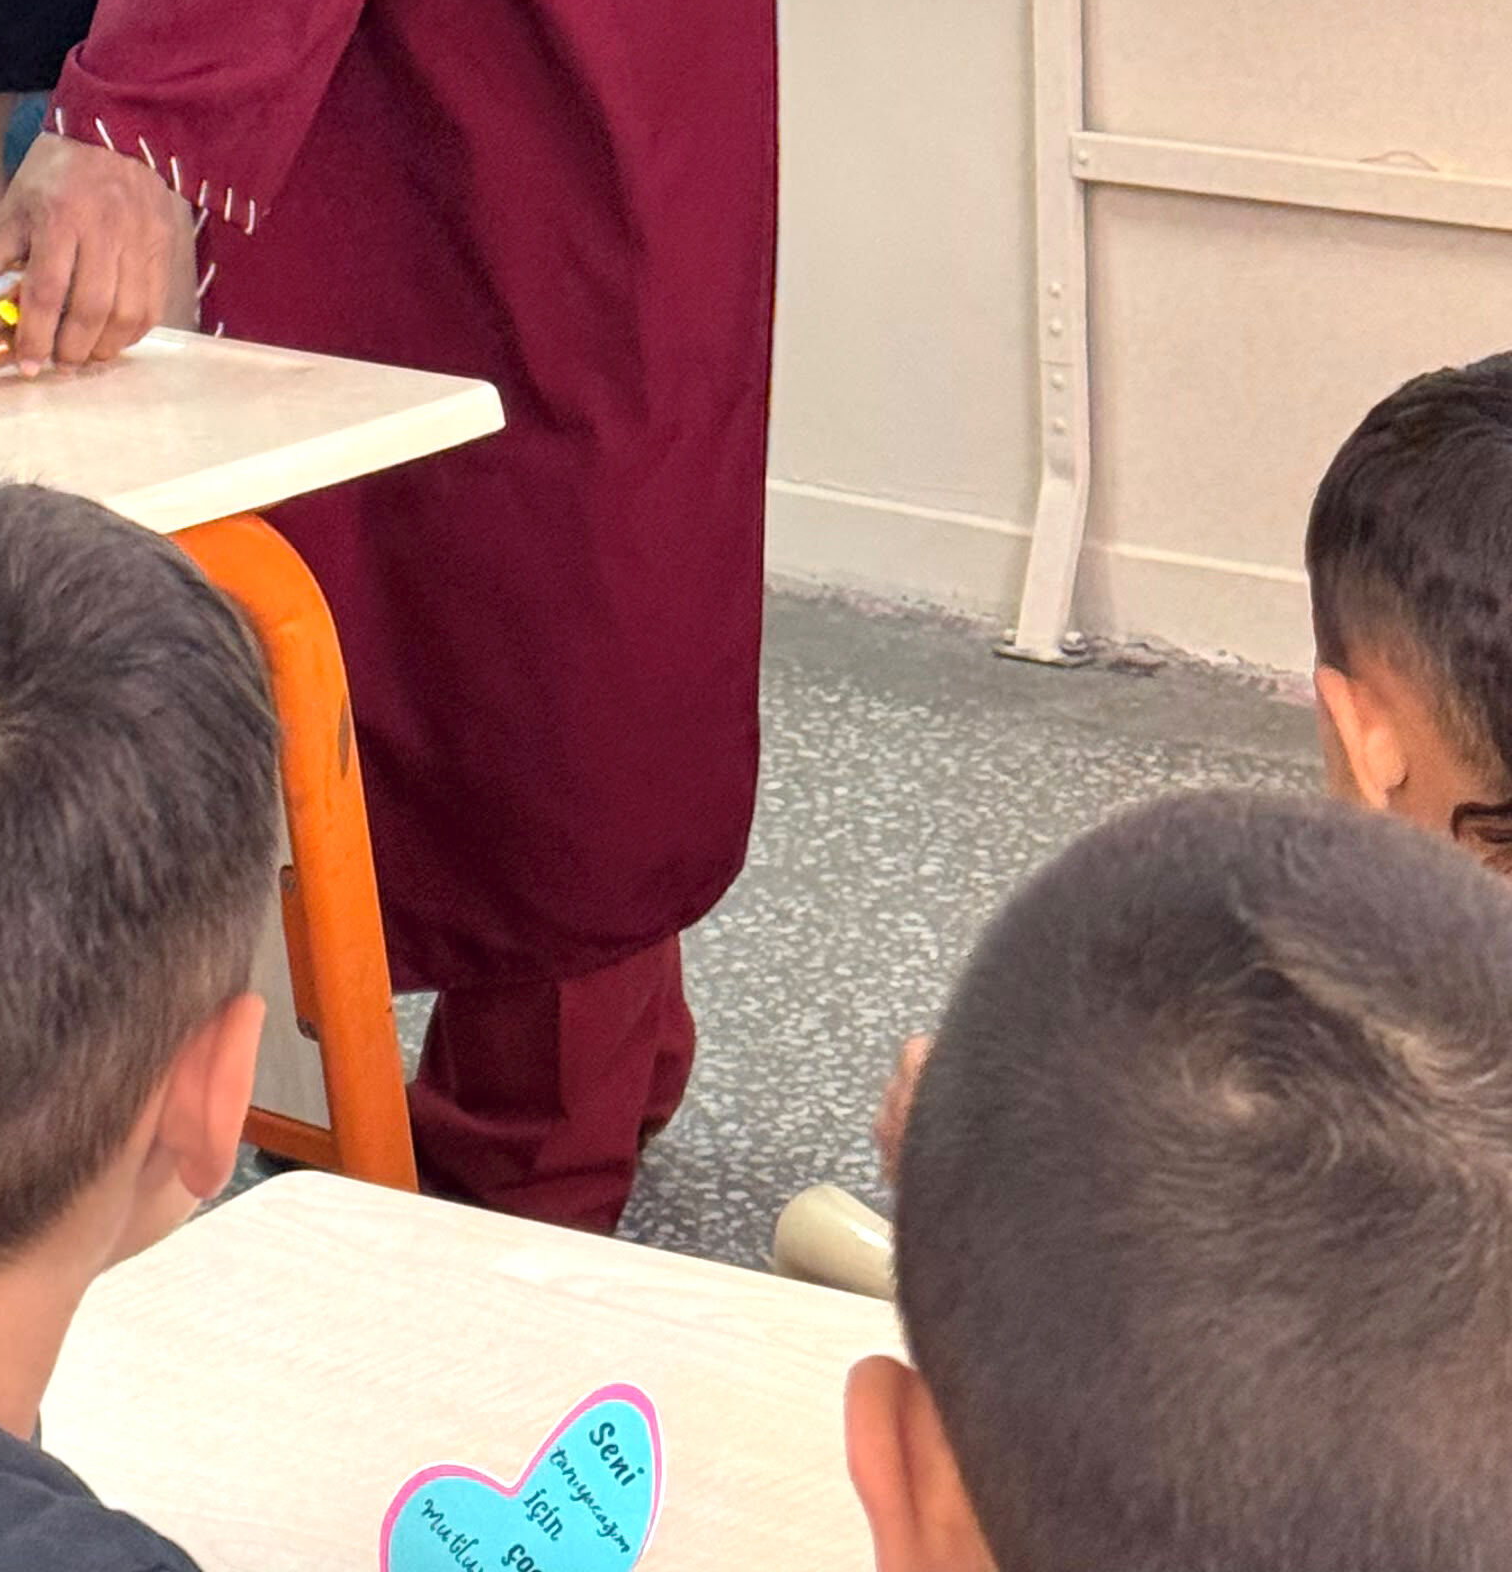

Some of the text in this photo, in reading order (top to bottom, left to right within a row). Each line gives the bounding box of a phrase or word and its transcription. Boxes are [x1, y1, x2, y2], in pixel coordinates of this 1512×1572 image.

[589, 1421, 645, 1486] Seni
[523, 1488, 564, 1542] için
[500, 1543, 542, 1572] ço
